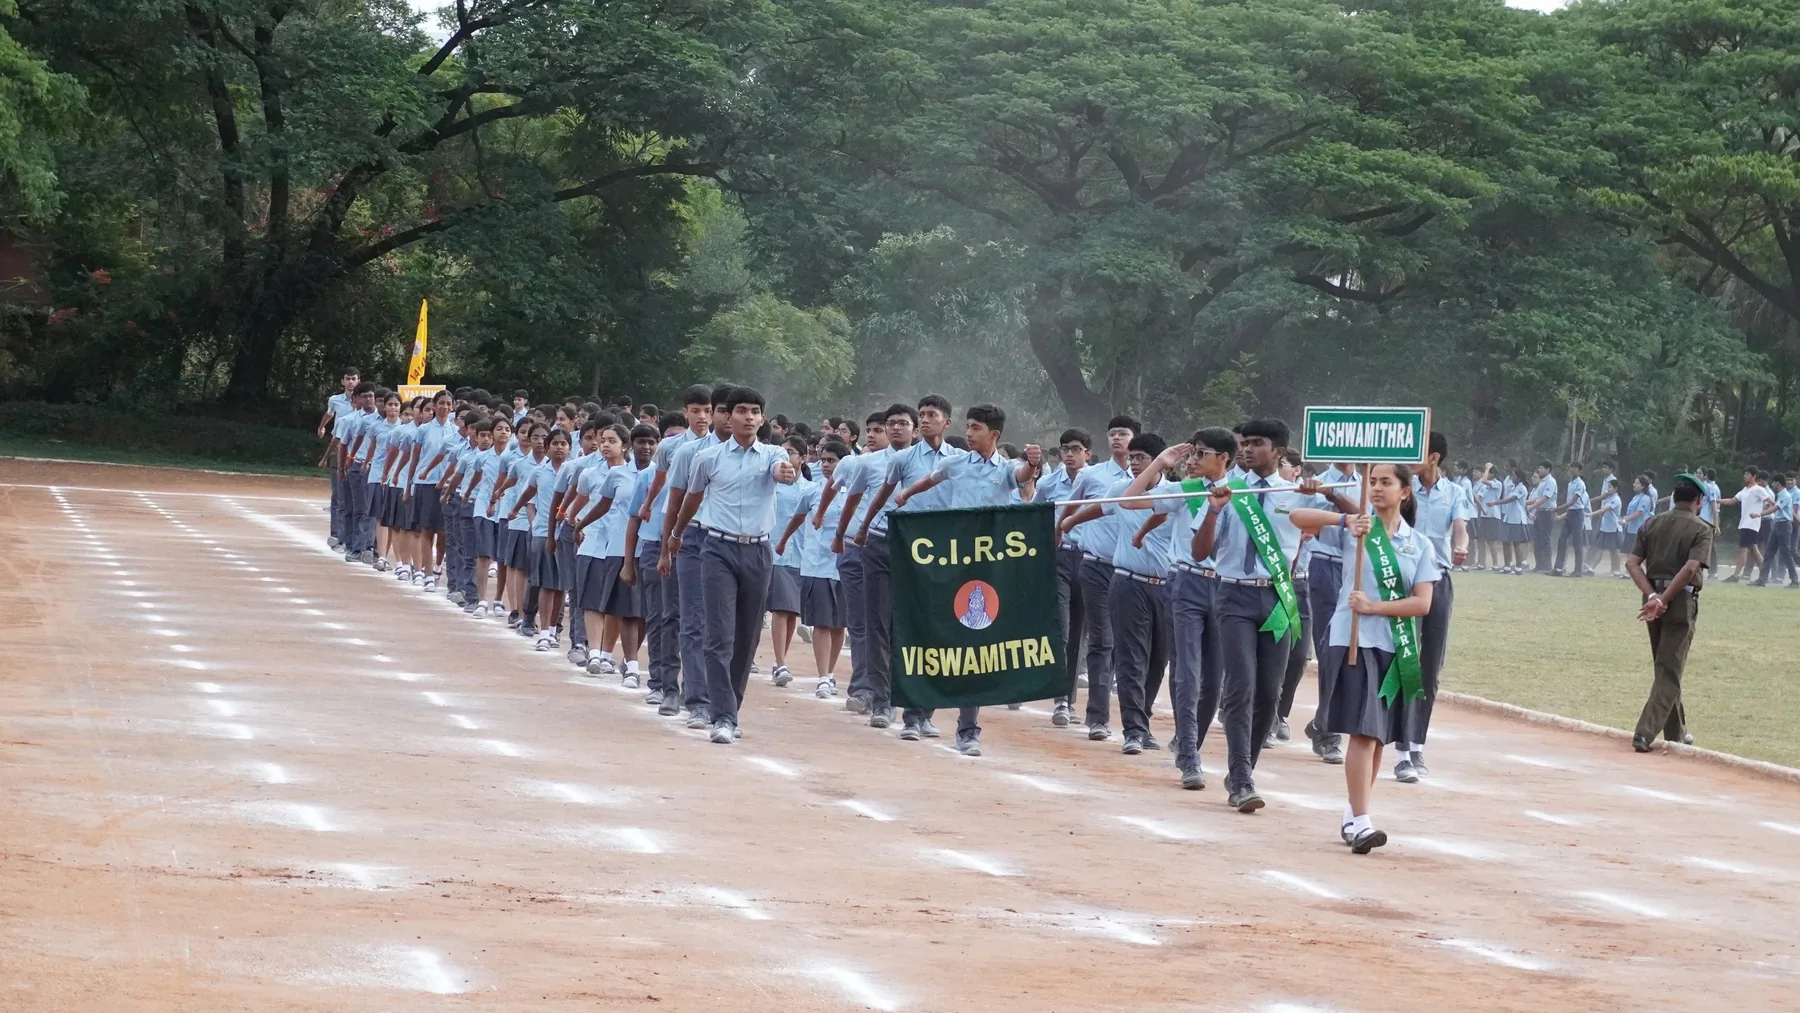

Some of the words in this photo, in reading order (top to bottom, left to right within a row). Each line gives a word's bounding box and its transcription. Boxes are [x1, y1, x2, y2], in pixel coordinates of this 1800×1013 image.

[1315, 421, 1414, 449] VISHWAMITHRA
[911, 531, 1037, 566] C.I.R.S.
[1238, 495, 1293, 602] VISHWAMITRA
[1370, 536, 1412, 658] VISHWAITRA
[902, 636, 1056, 677] VISWAMITRA
